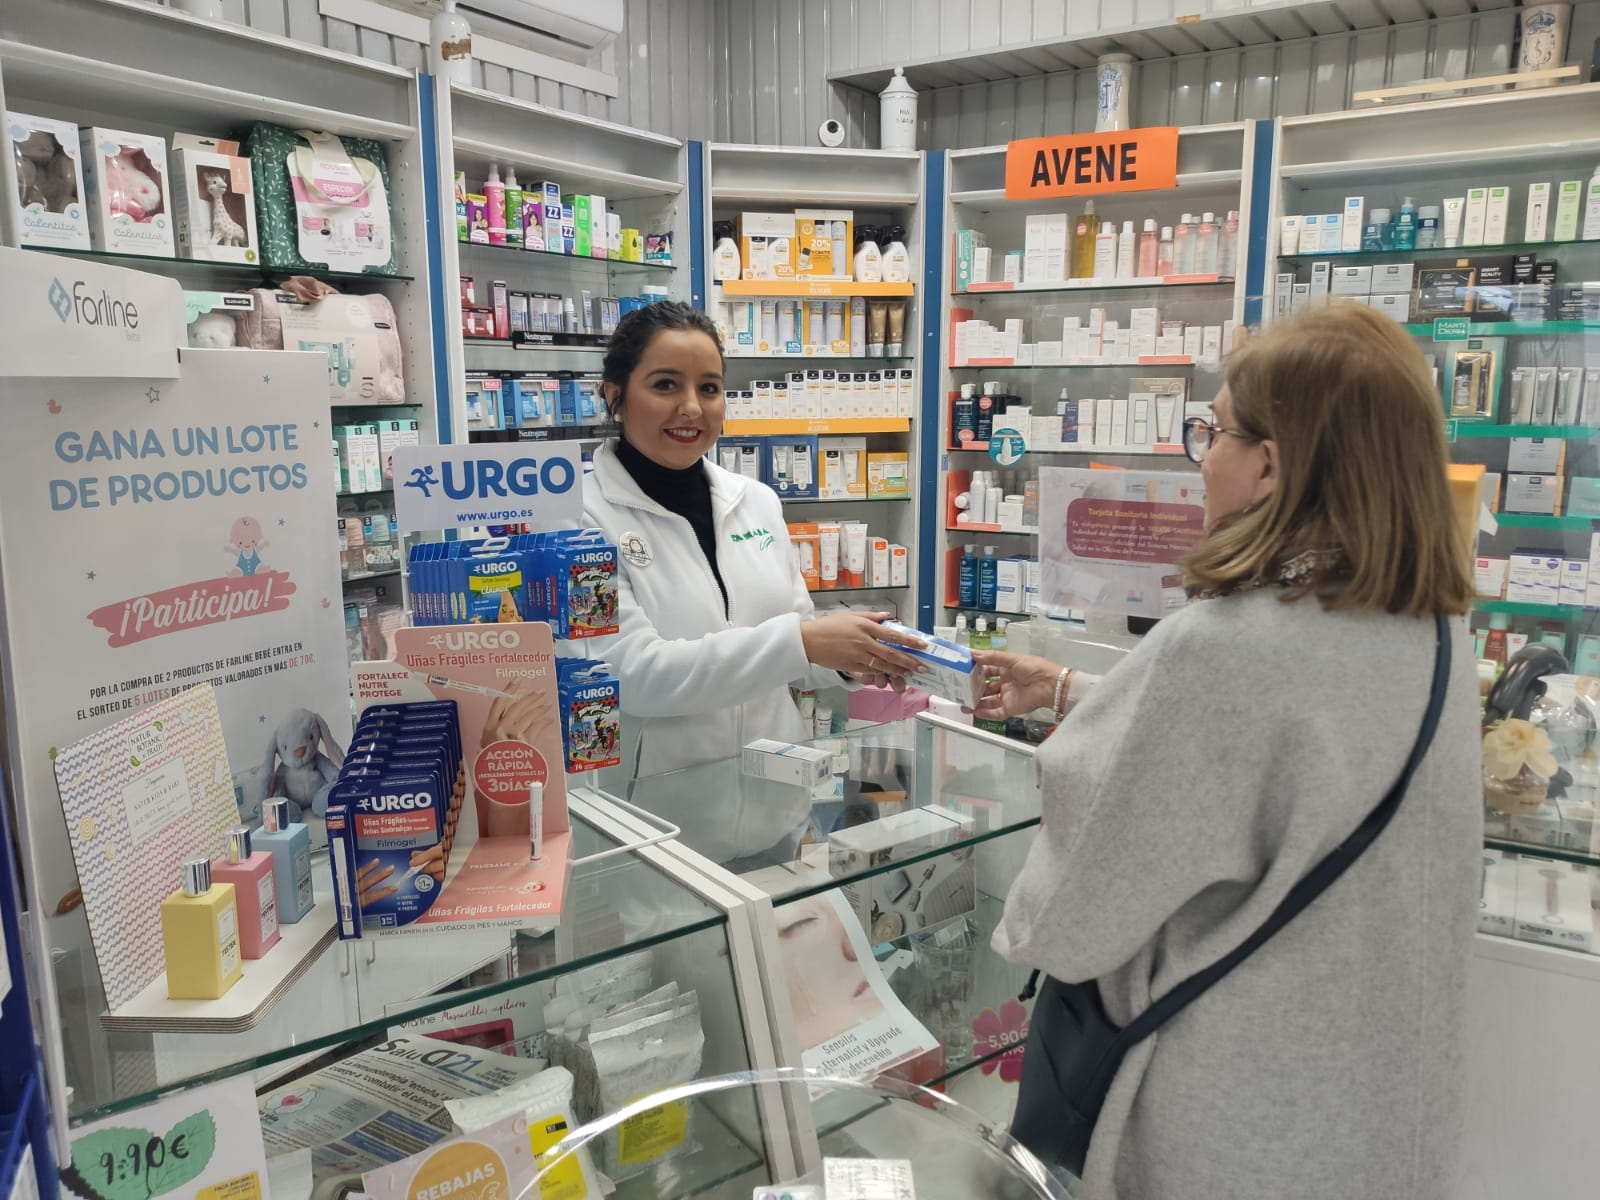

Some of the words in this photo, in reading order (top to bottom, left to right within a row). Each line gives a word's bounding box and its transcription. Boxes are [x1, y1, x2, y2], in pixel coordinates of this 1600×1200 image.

[1030, 143, 1138, 187] AVENE
[55, 428, 165, 463] GANA
[173, 426, 219, 456] UN
[226, 424, 299, 453] LOTE
[441, 457, 575, 500] URGO
[50, 477, 100, 511] DE
[109, 463, 307, 505] PRODUCTOS
[457, 508, 533, 522] www.urgo.es
[581, 551, 613, 564] URGO
[482, 561, 517, 574] URGO
[119, 577, 272, 637] ¡Participa!
[446, 630, 520, 650] URGO
[407, 653, 436, 667] Uñas
[439, 651, 485, 668] Frágiles
[489, 652, 550, 664] Fortalecedor
[90, 688, 107, 699] POR
[108, 683, 119, 695] LA
[121, 676, 153, 692] COMPRA
[154, 673, 164, 684] DE
[166, 671, 172, 682] 2
[173, 662, 214, 680] PRODUCTOS
[215, 659, 225, 670] DE
[226, 653, 253, 667] FARLINE
[254, 647, 272, 660] BEBÉ
[272, 644, 293, 657] ENTRA
[294, 641, 303, 652] EN
[357, 672, 409, 681] FORTALECE
[496, 667, 546, 680] Filmogel
[77, 710, 88, 721] EL
[89, 702, 120, 717] SORTEO
[122, 698, 132, 710] DE
[142, 688, 170, 705] LOTES
[224, 667, 263, 684] VALORADOS
[264, 664, 273, 675] EN
[274, 660, 288, 673] MÁS
[358, 681, 389, 690] NUTRE
[584, 686, 614, 699] URGO
[360, 689, 402, 698] PROTEGE
[486, 748, 534, 760] ACCIÓN
[488, 760, 533, 771] RÁPIDA
[371, 792, 432, 811] URGO
[363, 818, 379, 826] Uñas
[377, 836, 417, 848] Filmogel
[428, 907, 452, 917] Uñas
[455, 904, 494, 917] Frágiles
[496, 901, 553, 913] Fortalecedor
[436, 923, 467, 932] CUIDADO
[477, 922, 491, 930] PIES
[822, 1032, 858, 1055] Sensilis
[416, 1162, 495, 1200] REBAJAS
